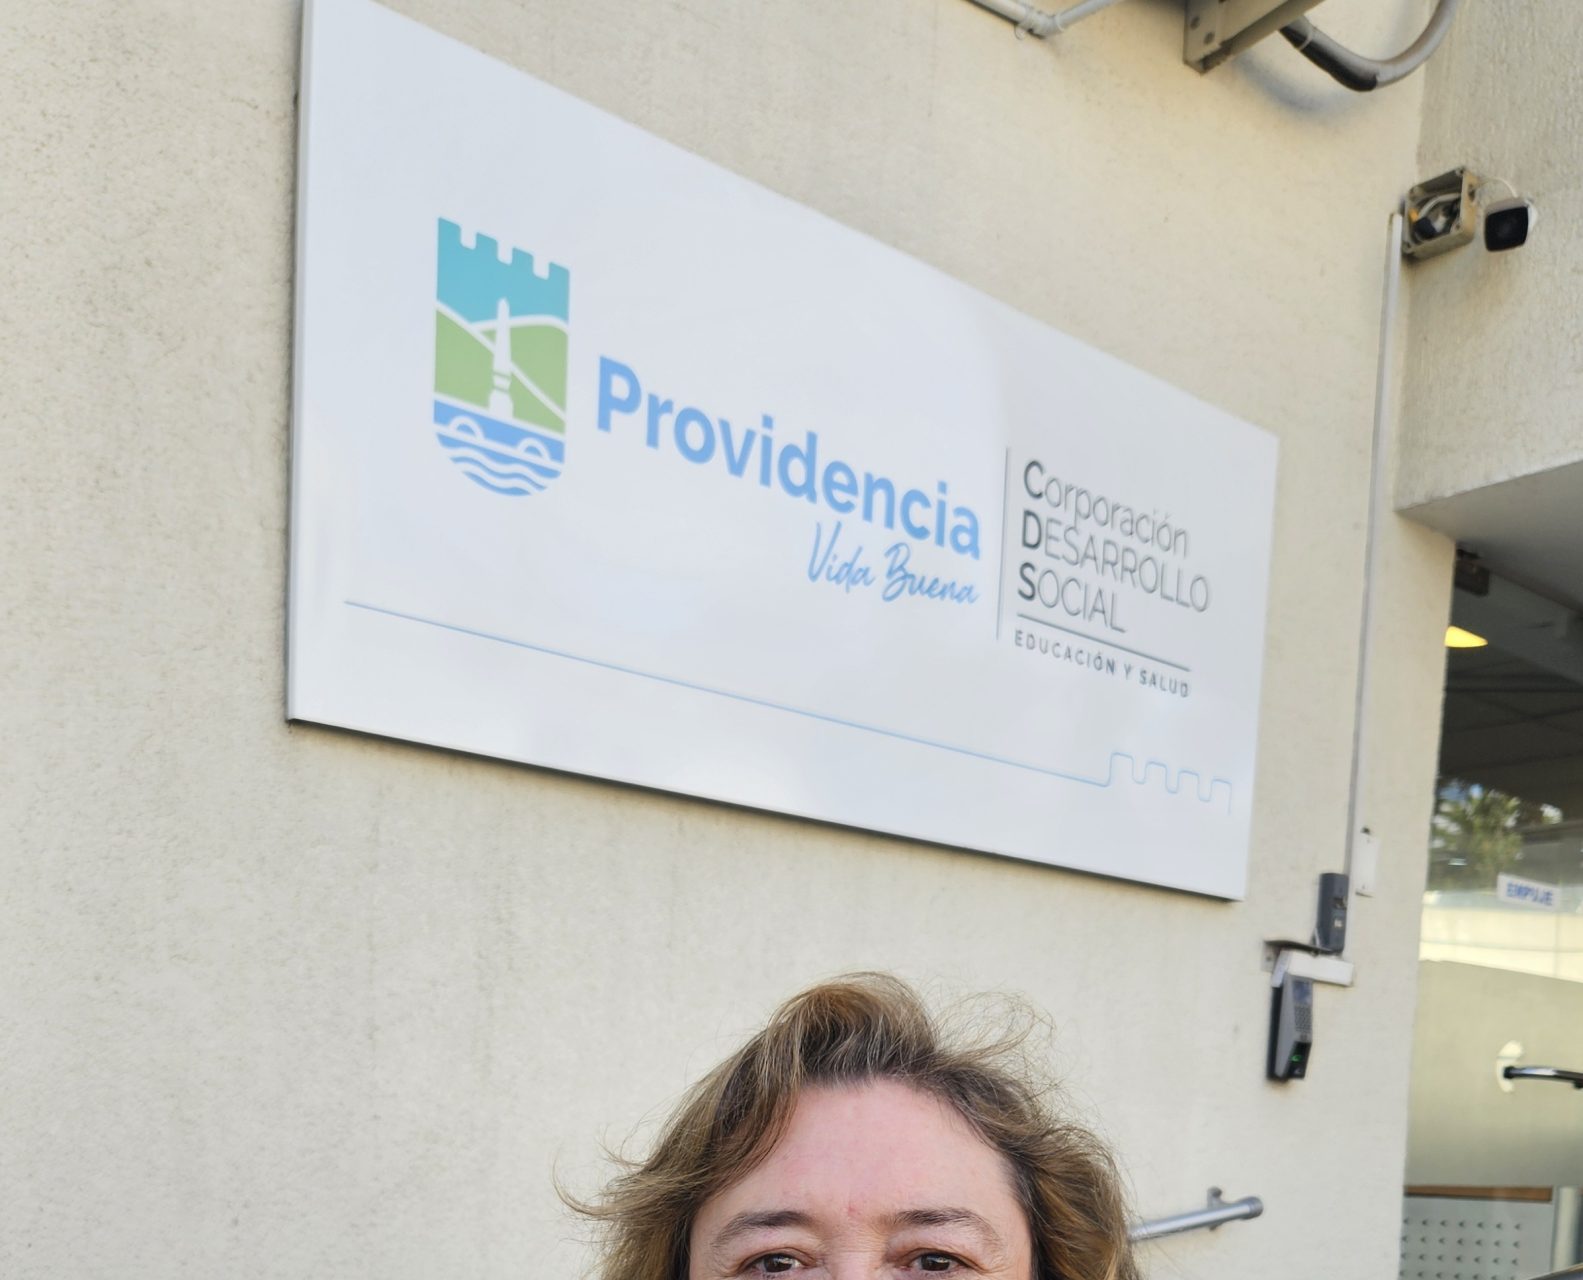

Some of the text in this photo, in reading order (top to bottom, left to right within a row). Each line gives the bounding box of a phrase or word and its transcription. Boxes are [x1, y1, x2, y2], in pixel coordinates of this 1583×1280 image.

[597, 355, 981, 560] Providencia
[1023, 459, 1188, 557] Corporación
[806, 520, 979, 604] Vida Buena
[1017, 562, 1127, 633] SOCIAL
[1021, 509, 1209, 612] DESARROLLO
[1014, 631, 1189, 698] EDUCACIÓN Y SALUD
